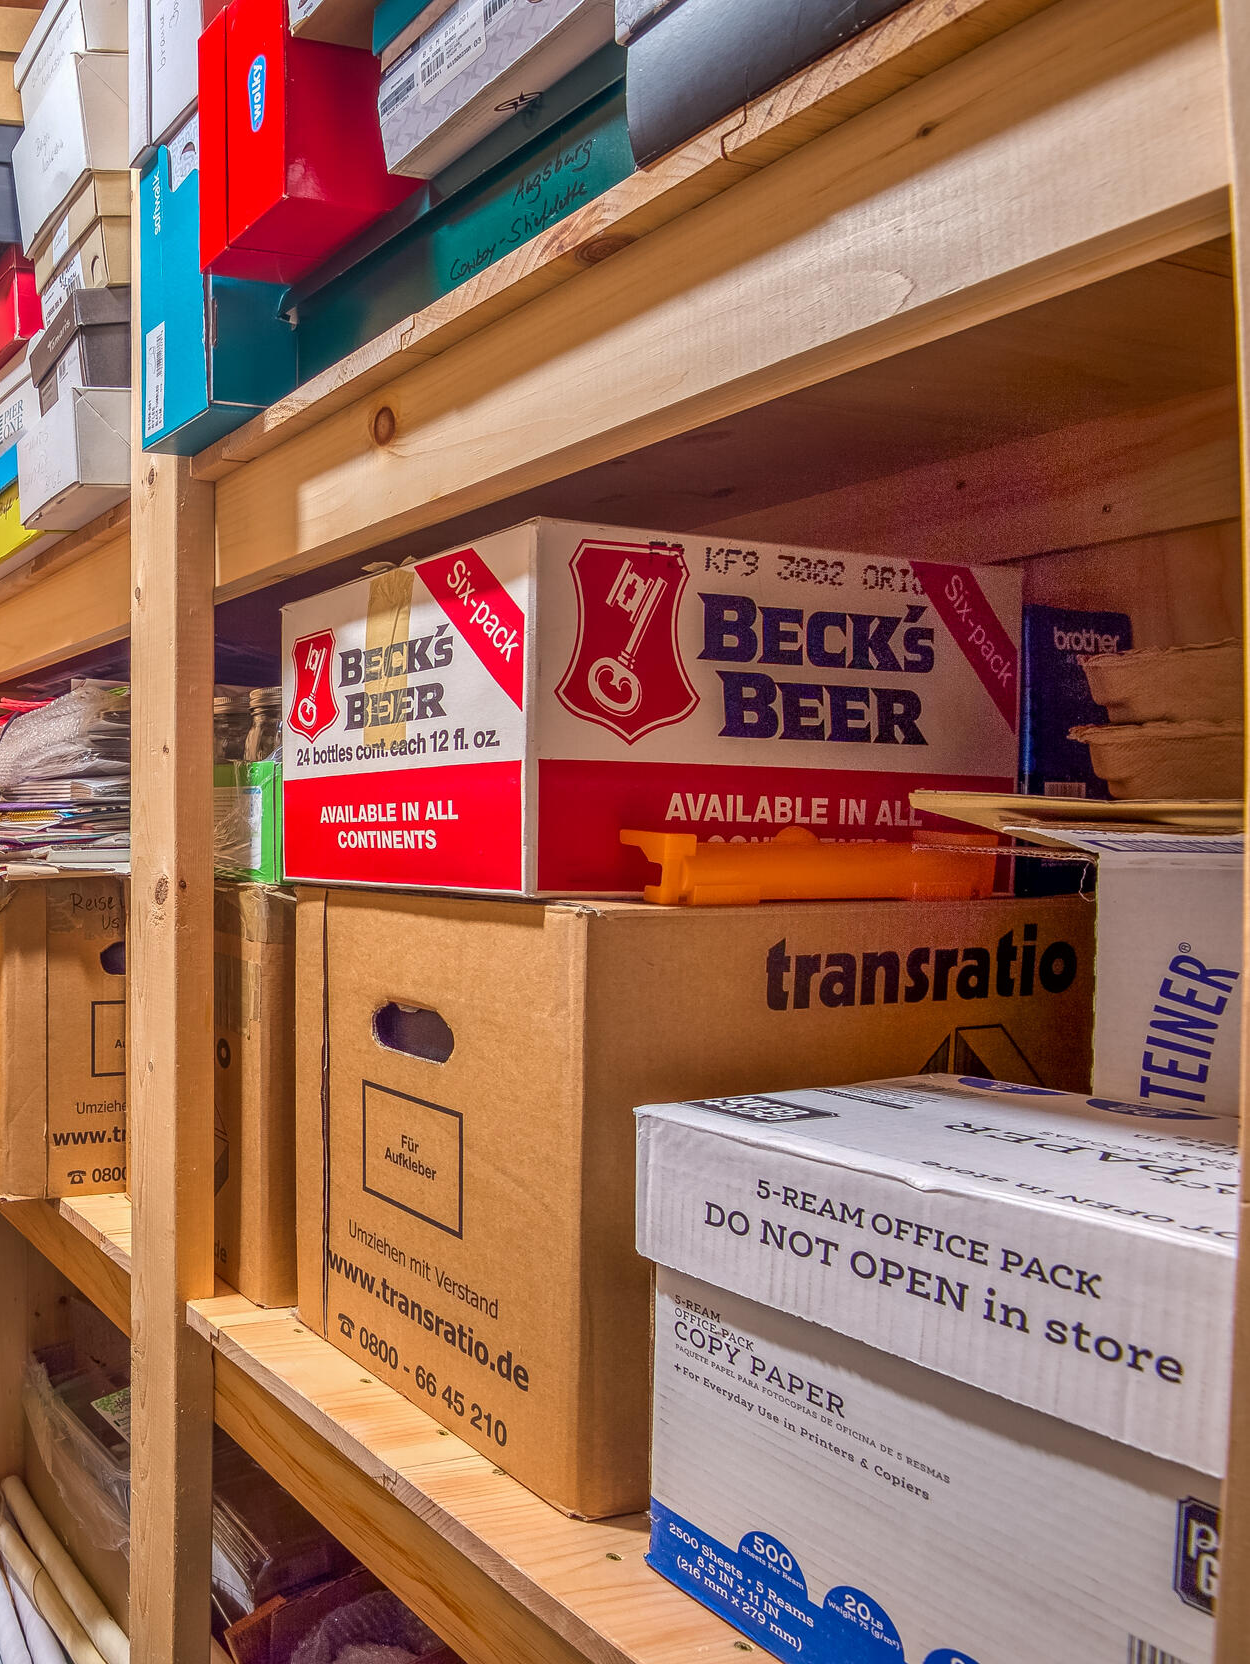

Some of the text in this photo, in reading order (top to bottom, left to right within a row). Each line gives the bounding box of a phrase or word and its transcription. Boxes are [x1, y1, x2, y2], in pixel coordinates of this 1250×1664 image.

[512, 138, 593, 207] Augsburg
[152, 169, 162, 236] softwalk
[2, 398, 24, 423] PIER
[2, 416, 24, 441] ONE
[446, 558, 520, 663] Six-pack
[944, 573, 1016, 688] Six-pack
[1053, 626, 1120, 653] brother
[344, 682, 447, 732] BEER
[715, 669, 930, 746] BEER
[296, 728, 500, 767] 24 bottles cont. each 12 fl. oz.
[320, 799, 459, 824] AVAILABLE IN ALL
[664, 791, 923, 827] AVAILABLE IN ALL
[337, 828, 437, 850] CONTINENTS
[764, 922, 1079, 1012] transratio
[75, 1100, 127, 1116] Umziehe
[384, 1147, 438, 1182] Aufkleber
[400, 1133, 421, 1155] Für
[944, 1121, 1205, 1177] PAPER
[922, 1160, 1009, 1183] store
[1015, 1182, 1054, 1194] in
[1055, 1193, 1175, 1223] OPEN
[757, 1179, 1103, 1301] 5-REAM OFFICE PACK
[348, 1218, 500, 1321] Umziehen mit Verstand
[705, 1200, 1185, 1385] DO NOT OPEN in store
[326, 1249, 530, 1393] www.transratio.de
[674, 1294, 721, 1323] 5-REAM
[674, 1306, 755, 1352] OFFICE PACK
[359, 1325, 399, 1371] 0800
[415, 1364, 438, 1398] 66
[441, 1384, 466, 1418] 45
[469, 1401, 509, 1448] 210
[674, 1320, 846, 1419] COPY PAPER
[675, 1343, 951, 1485] PAQUETE PAPEL PARA FOTOCOPIAS DE OFICINA DE 5 RESMAS
[702, 1377, 930, 1501] Everyday Use in Printers & Copiers
[669, 1522, 815, 1629] 2500 Sheets 5 Reams
[741, 1545, 805, 1591] Sheets Per Ream
[752, 1534, 793, 1572] 500
[676, 1554, 803, 1652] (216 mm x 279 mm)
[696, 1555, 780, 1620] 8.5 IN x 11 IN
[827, 1598, 858, 1625] Weight
[858, 1618, 869, 1632] 75
